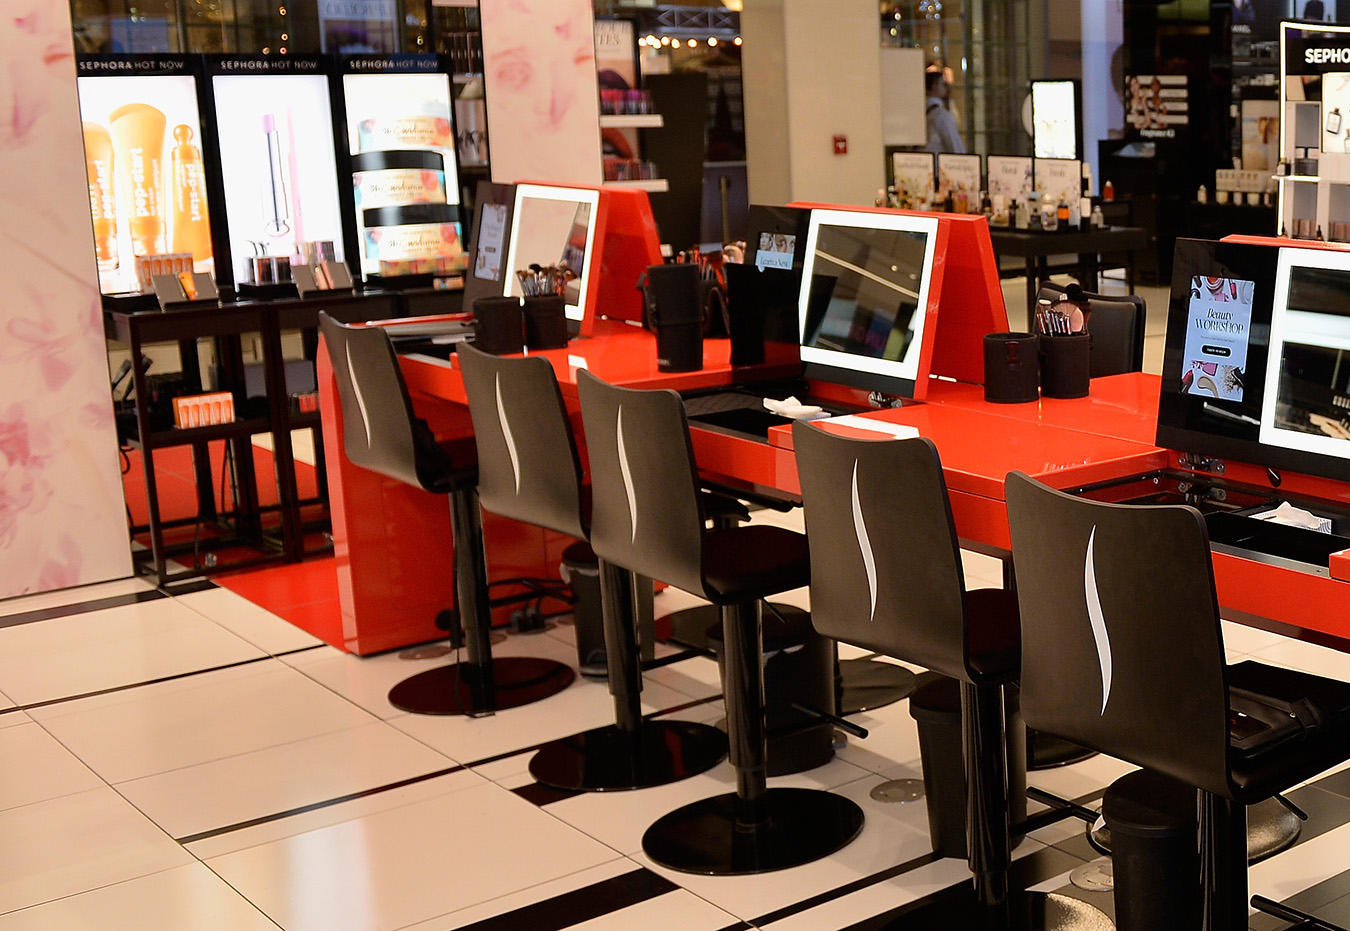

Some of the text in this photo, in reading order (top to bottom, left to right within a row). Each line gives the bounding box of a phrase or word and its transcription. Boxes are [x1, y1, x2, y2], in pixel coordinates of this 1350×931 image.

[79, 61, 184, 70] SEPHORA HOT NOW
[220, 60, 318, 70] SEPHORA HOT NOW
[350, 60, 439, 70] SEPHORA HOT NOW
[1206, 308, 1233, 320] Beauty
[1195, 318, 1244, 334] WORKSHOP
